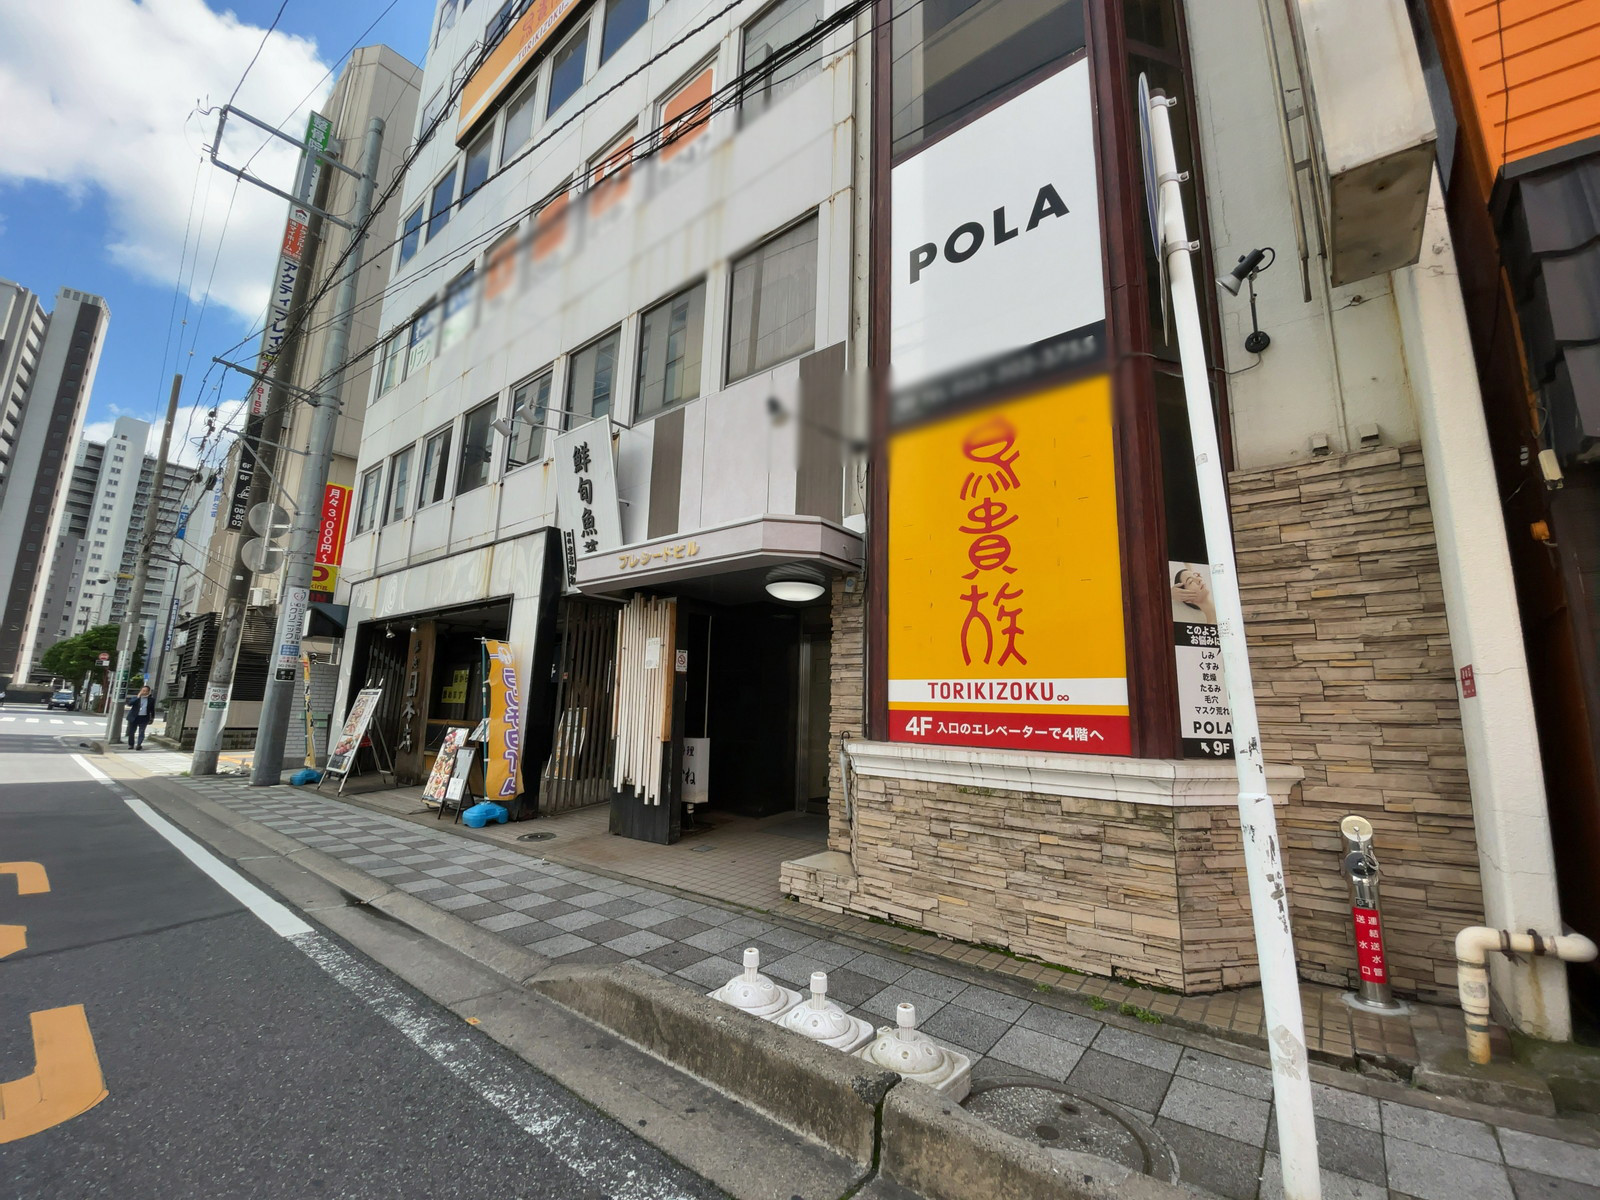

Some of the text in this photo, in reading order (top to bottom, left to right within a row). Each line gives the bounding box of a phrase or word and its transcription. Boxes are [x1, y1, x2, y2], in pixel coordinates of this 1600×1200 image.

[909, 182, 1071, 285] POLA
[1186, 625, 1219, 636] このよう
[1201, 651, 1215, 660] しみ
[1198, 662, 1220, 670] くすみ
[1202, 673, 1217, 681] 乾燥
[927, 681, 1055, 701] TORIKIZOKU
[1200, 684, 1222, 693] たるみ
[1204, 695, 1219, 704] 毛穴
[1194, 706, 1230, 715] マスク荒れ
[905, 716, 1105, 742] 4F 入口のエレベーターで4階へ
[1193, 721, 1233, 735] POLA
[1212, 740, 1230, 756] 9F
[1355, 914, 1371, 975] 送水口
[1368, 916, 1383, 977] 連結送水管
